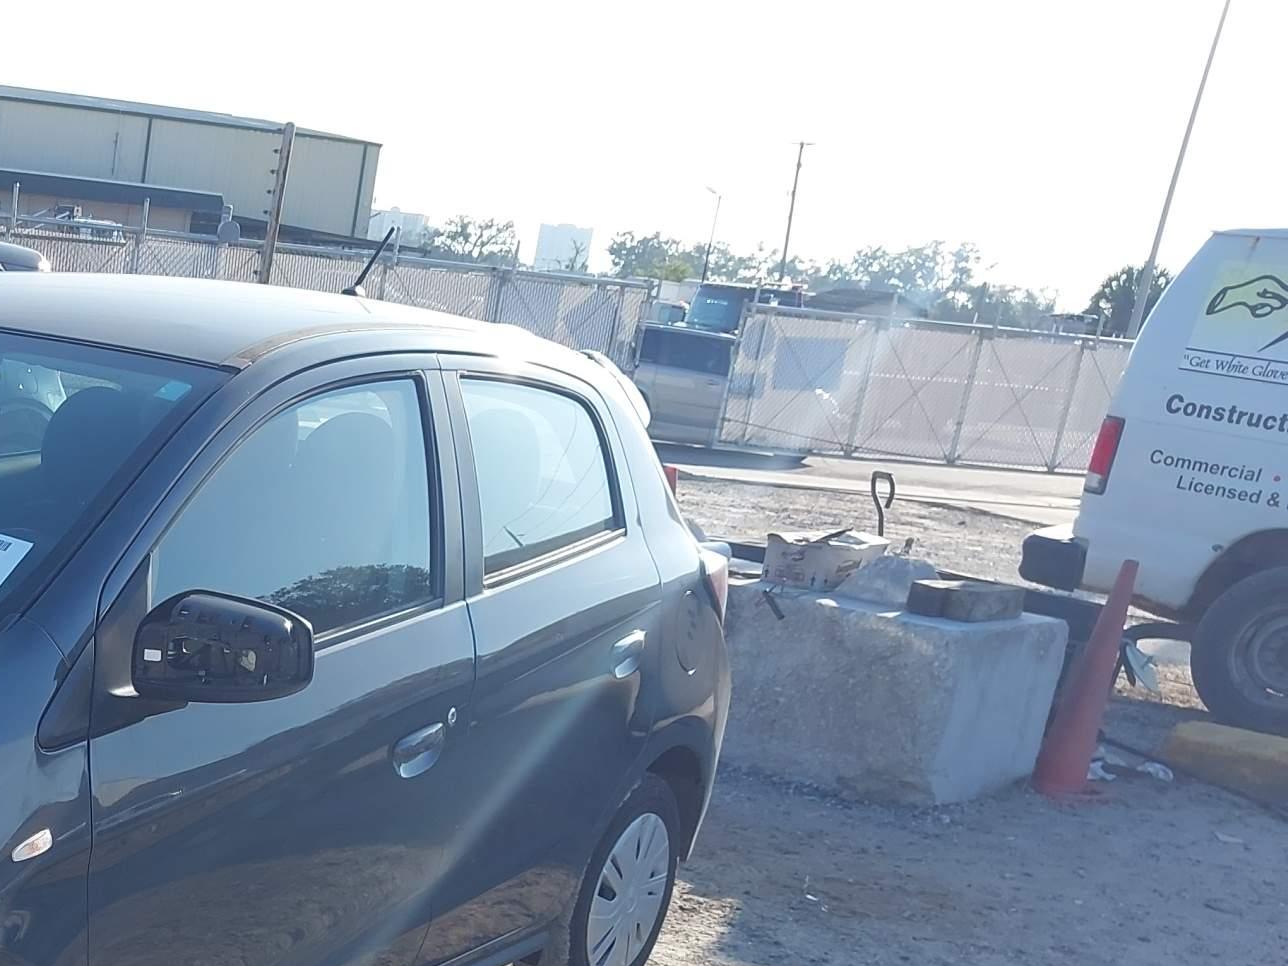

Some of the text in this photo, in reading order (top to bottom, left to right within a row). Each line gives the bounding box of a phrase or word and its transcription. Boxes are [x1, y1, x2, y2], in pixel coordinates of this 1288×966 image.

[1215, 355, 1249, 375] White
[1252, 360, 1288, 381] Glove
[1166, 394, 1288, 433] Construct
[1150, 449, 1263, 483] Commercial
[1176, 475, 1280, 508] Licensed &
